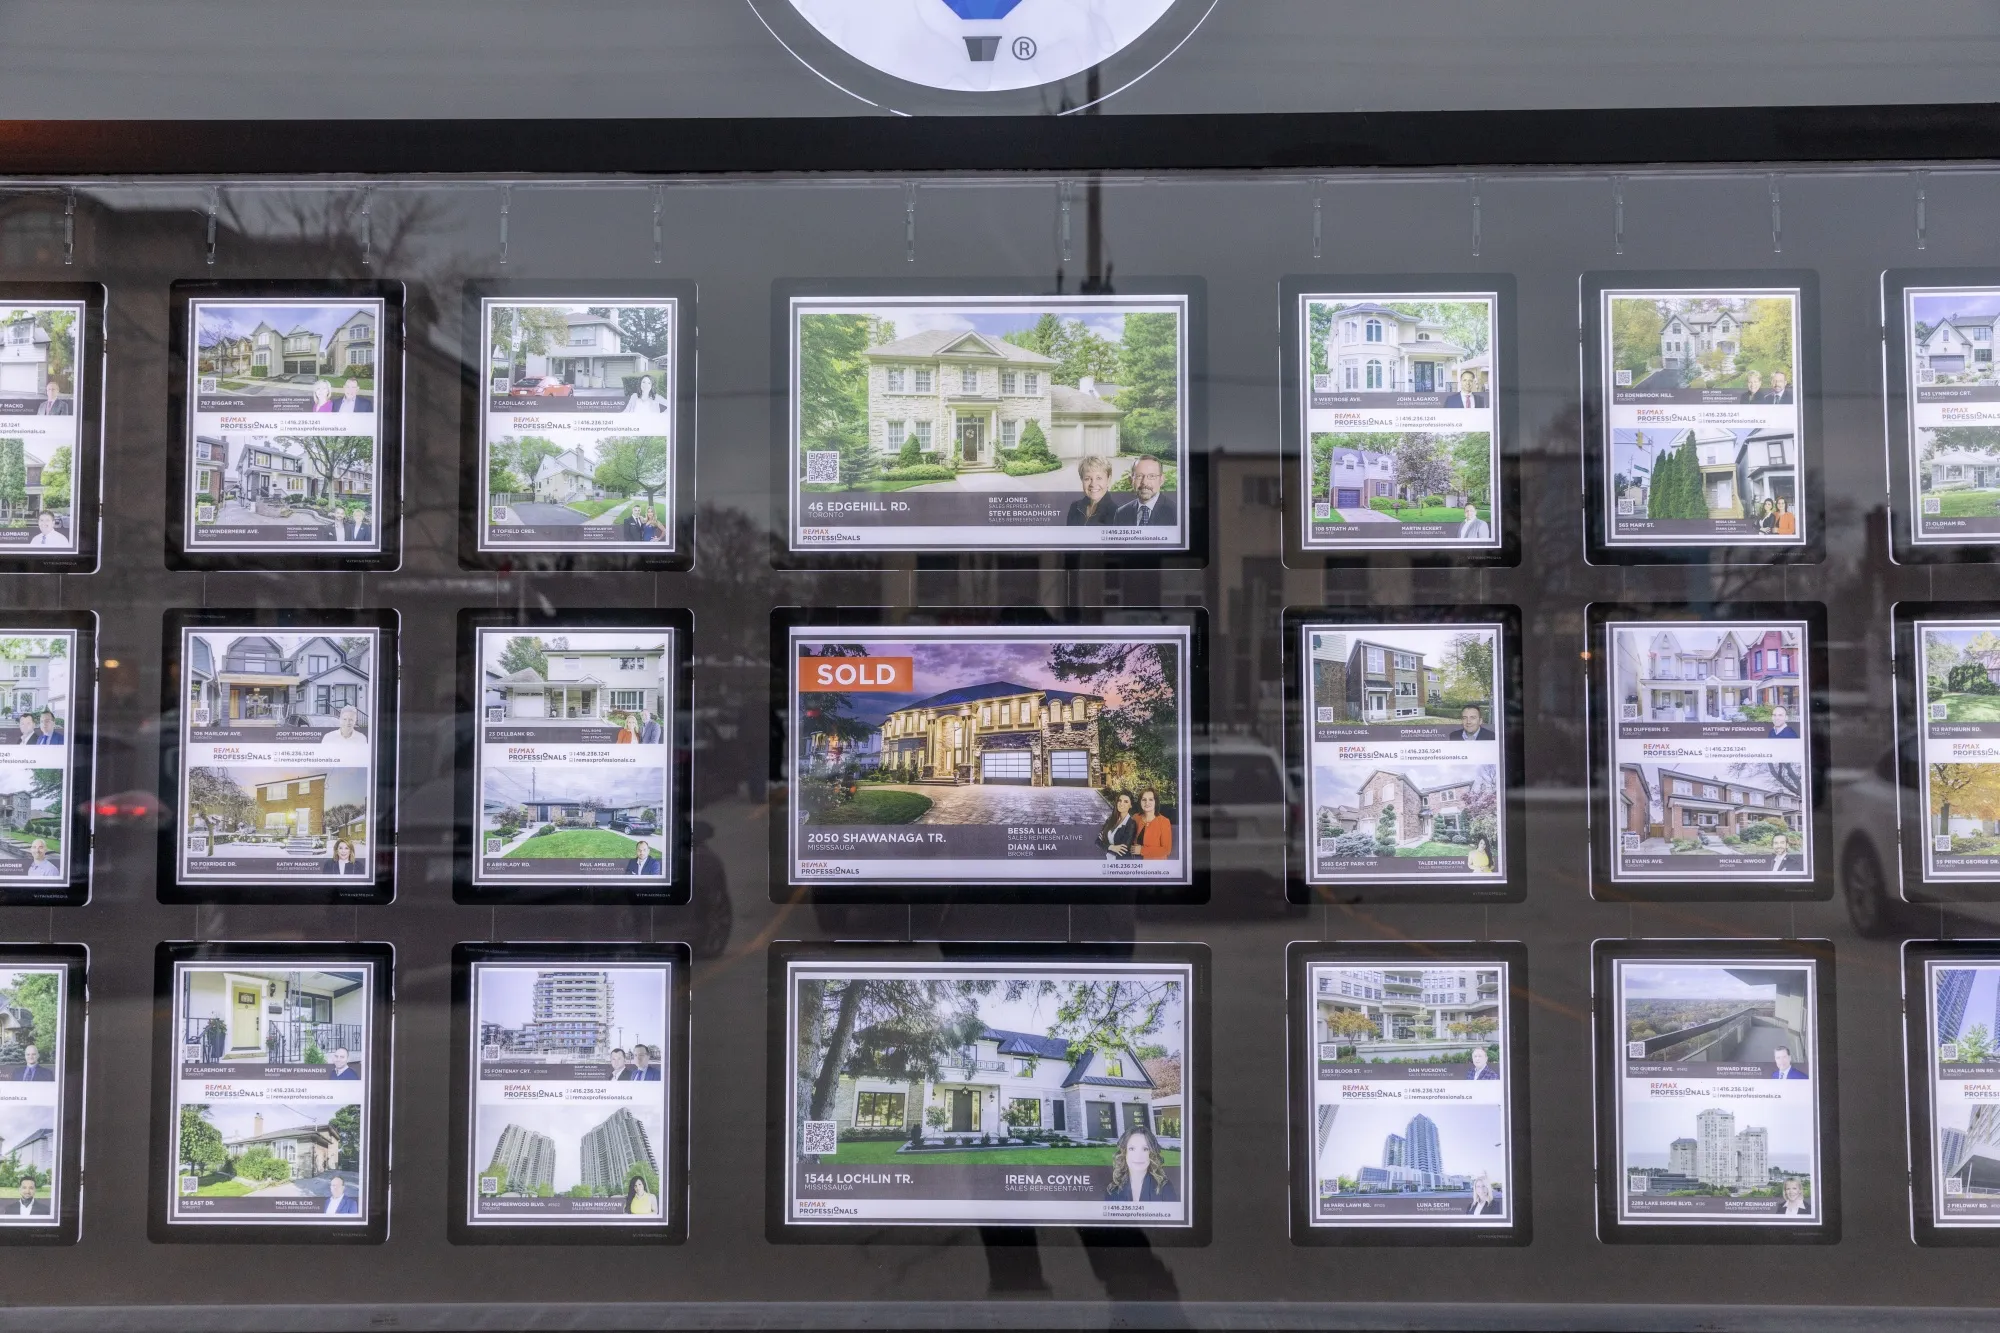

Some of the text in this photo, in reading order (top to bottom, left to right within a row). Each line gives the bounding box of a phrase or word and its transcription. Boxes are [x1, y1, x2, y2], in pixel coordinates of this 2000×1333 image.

[808, 502, 910, 511] 46 EDGEHILL RD.
[817, 664, 895, 685] SOLD
[808, 834, 946, 843] 2050 SHAWANAGA TR.
[801, 866, 859, 874] PROFESSIONALS
[804, 1174, 914, 1184] 1544 LOCHLIN TR.
[1005, 1175, 1090, 1184] IRENA COYNE
[800, 1206, 858, 1214] PROFESSIONALS
